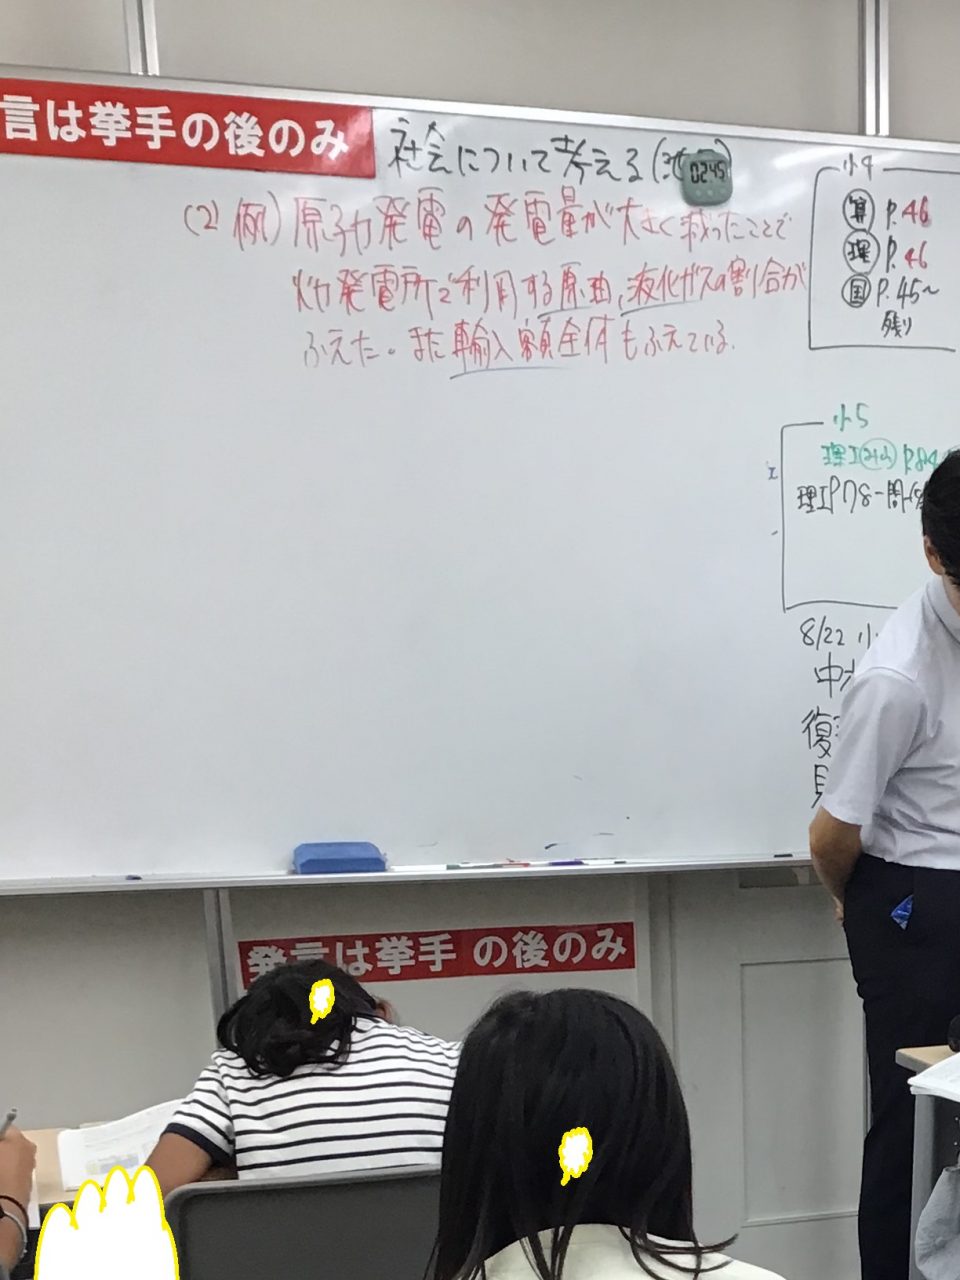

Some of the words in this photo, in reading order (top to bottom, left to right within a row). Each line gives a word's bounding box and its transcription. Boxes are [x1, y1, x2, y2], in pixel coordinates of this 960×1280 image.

[0, 94, 349, 160] 言は挙手の後のみ
[833, 403, 869, 431] 小5
[800, 616, 845, 651] 8/22
[801, 706, 840, 759] 復
